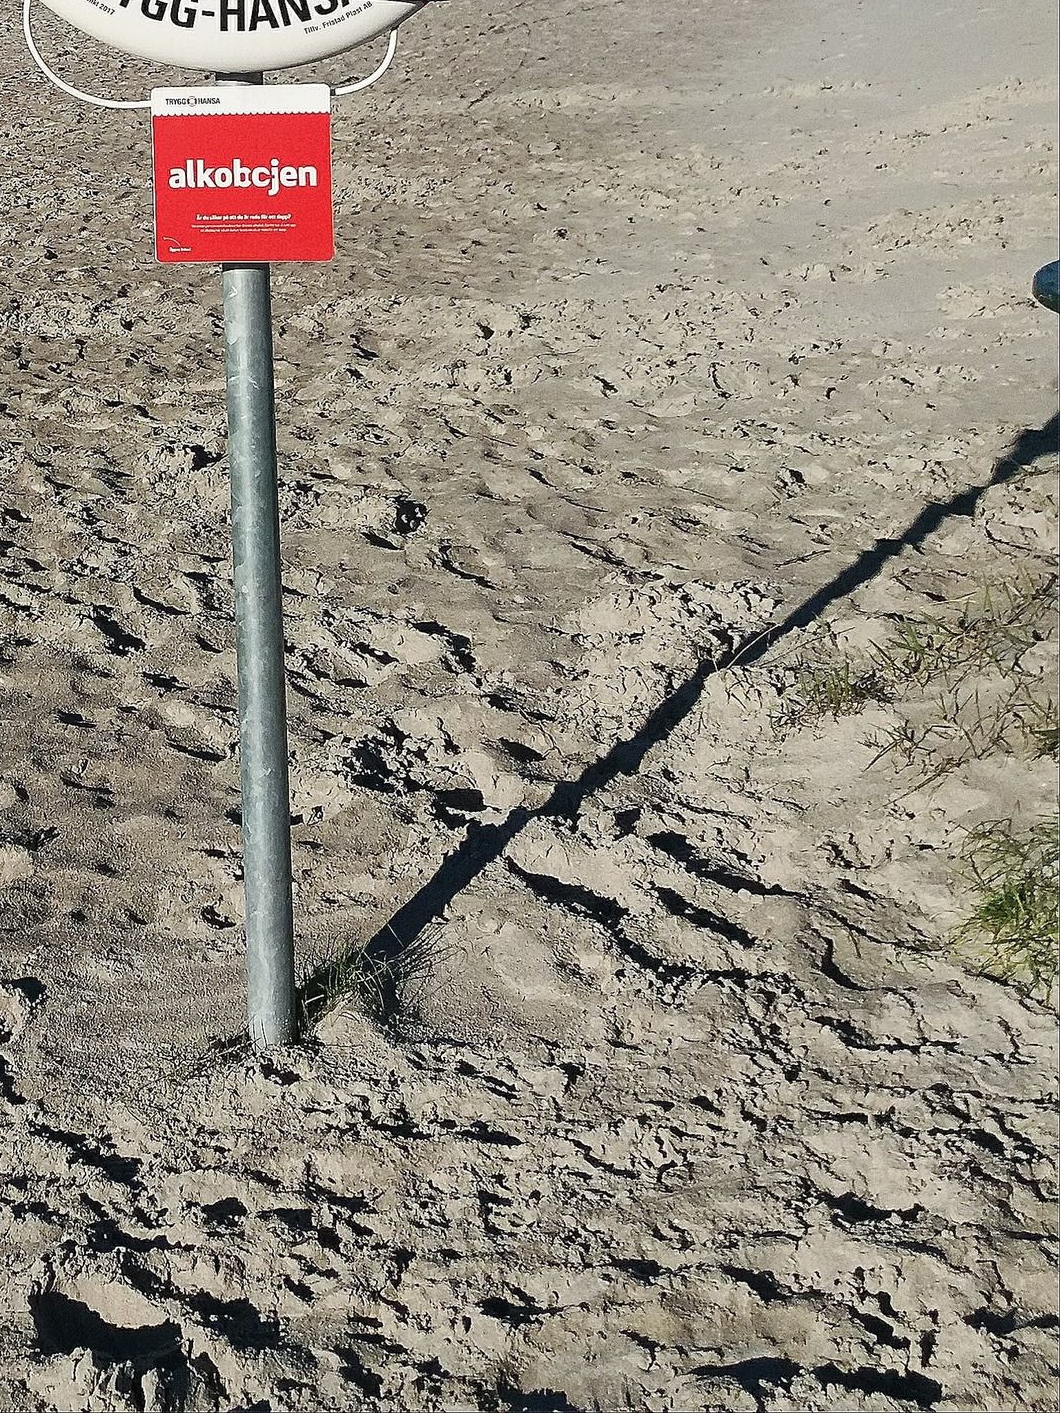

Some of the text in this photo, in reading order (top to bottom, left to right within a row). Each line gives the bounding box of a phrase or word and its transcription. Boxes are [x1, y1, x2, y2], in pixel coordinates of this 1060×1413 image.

[99, 3, 115, 15] 2017
[322, 15, 345, 28] Fristad
[345, 6, 363, 18] Plast
[363, 0, 373, 10] AB
[198, 97, 221, 105] HANSA
